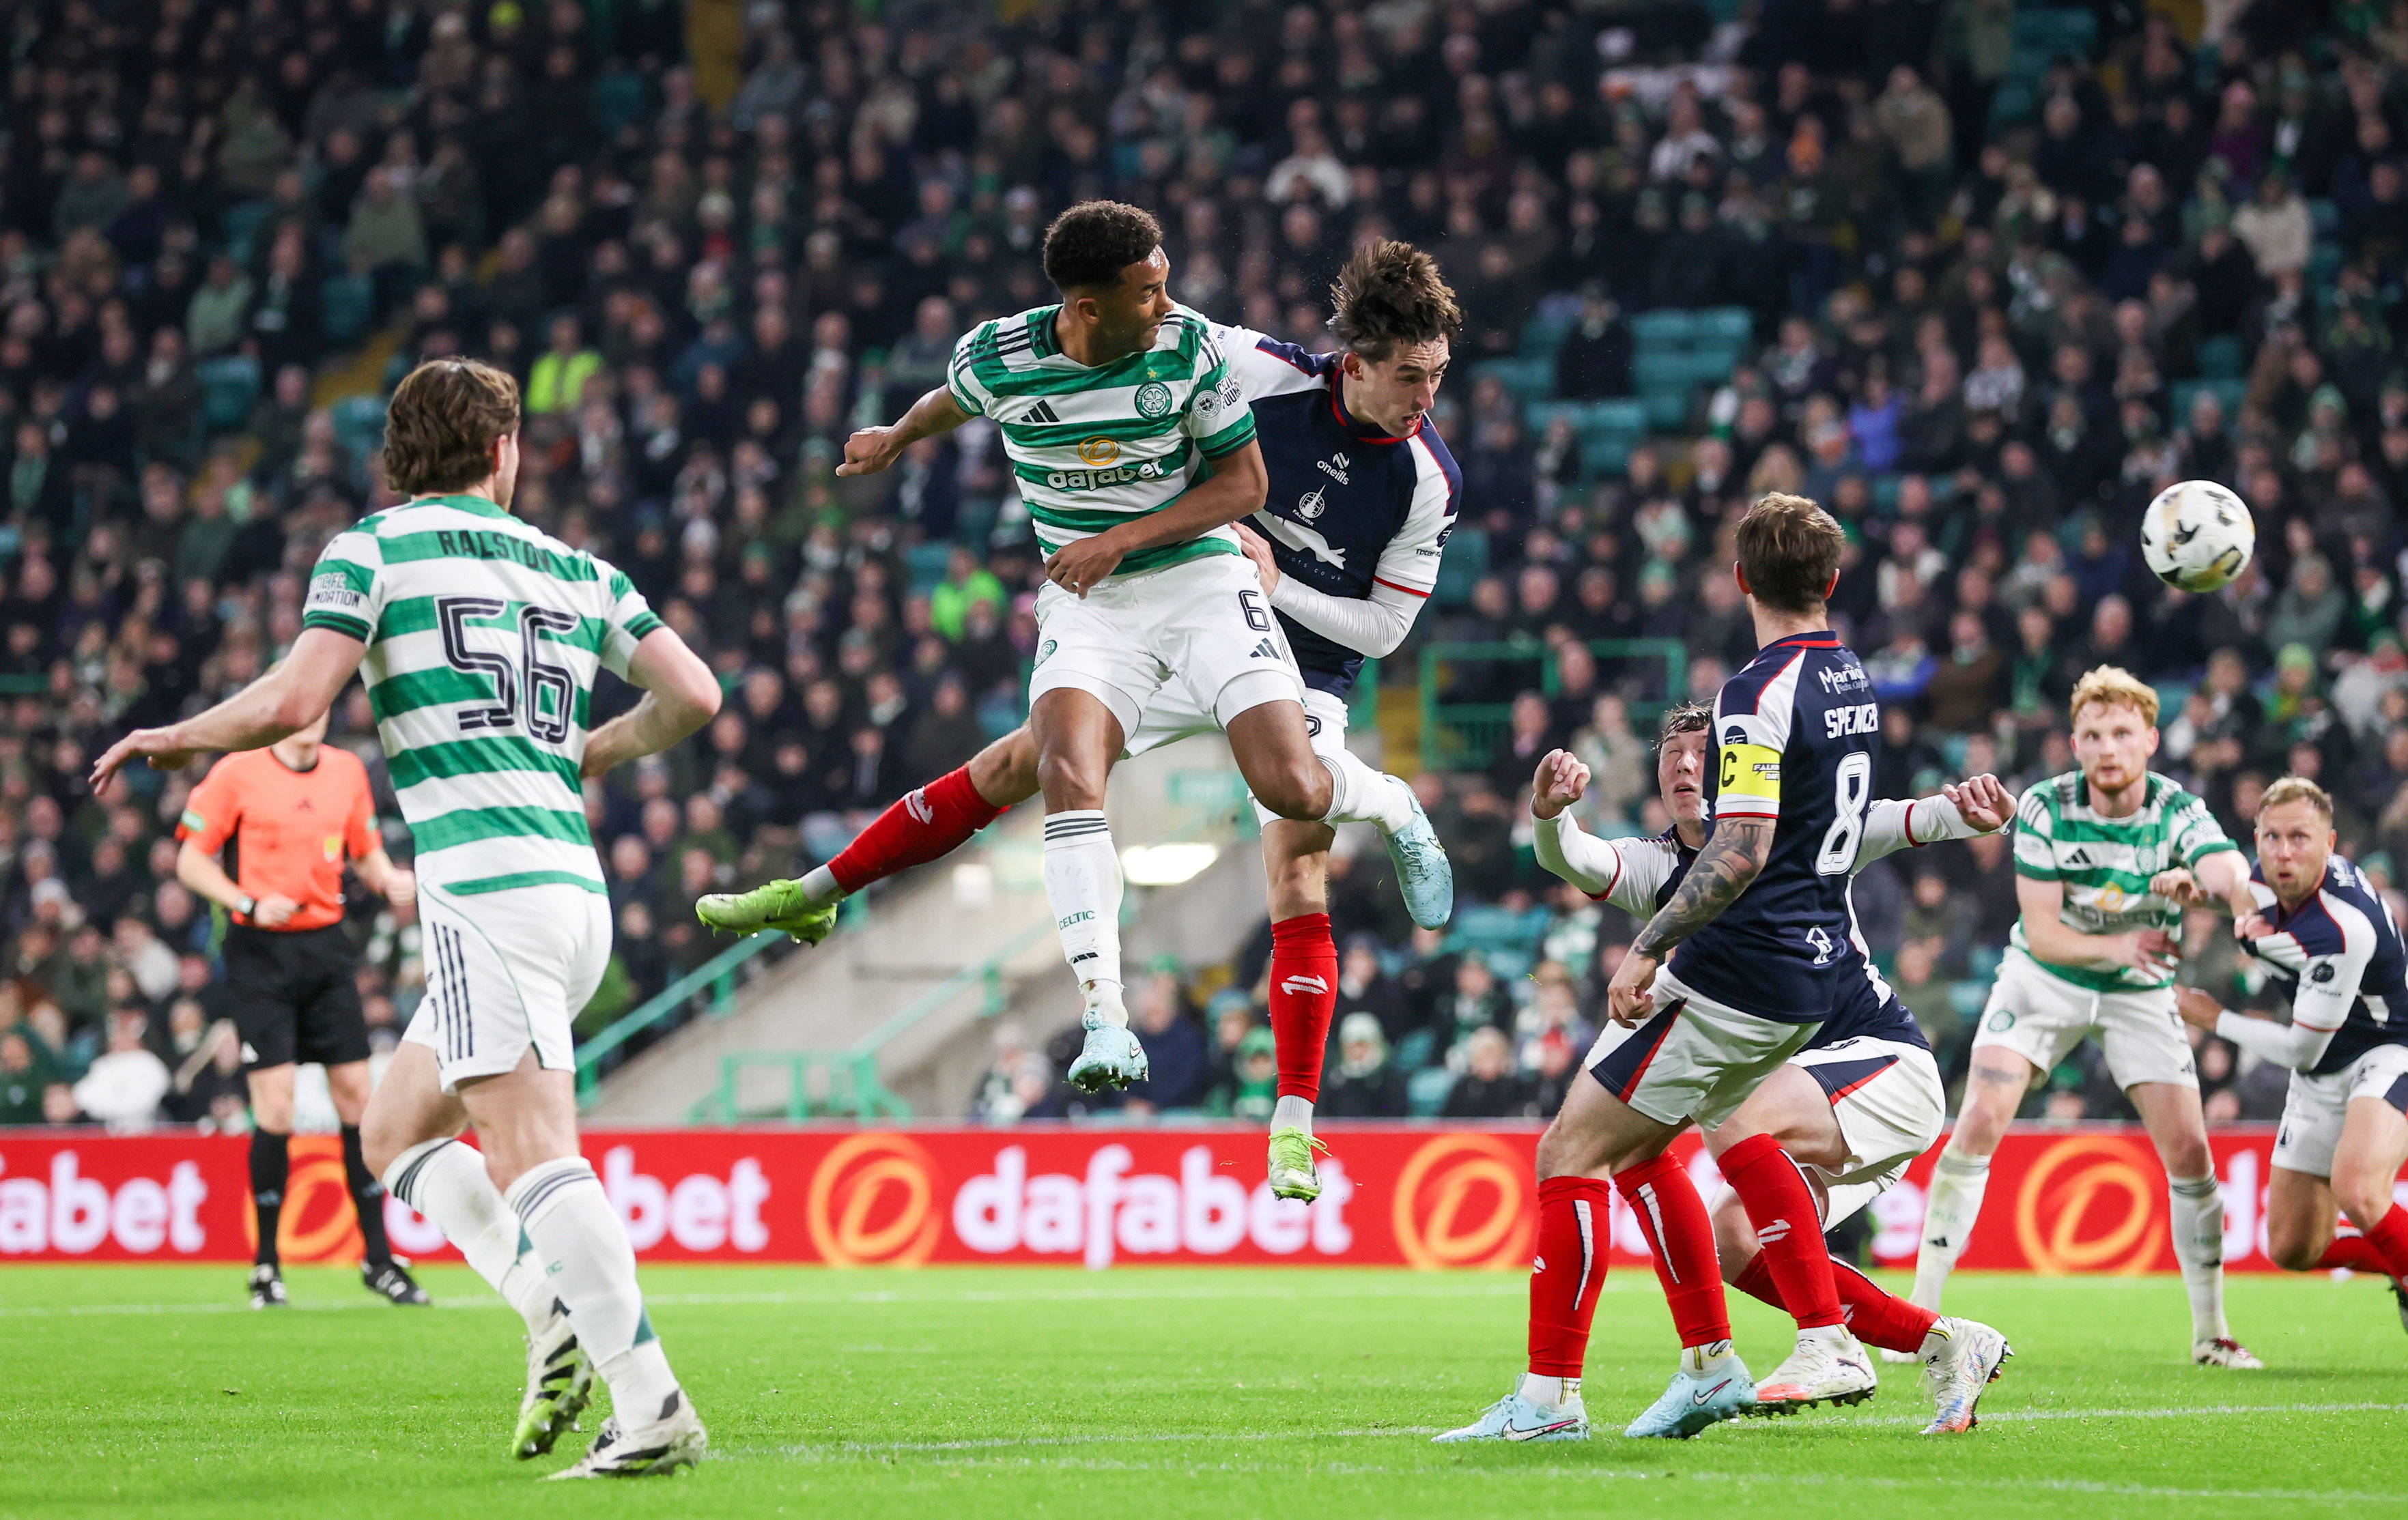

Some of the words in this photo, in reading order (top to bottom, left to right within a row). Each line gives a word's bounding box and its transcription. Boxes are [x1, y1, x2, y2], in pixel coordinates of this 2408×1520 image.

[1316, 460, 1350, 485] o'neills
[1292, 508, 1315, 527] FALKIRK
[437, 530, 551, 573] RALSTON
[1238, 590, 1270, 632] 6
[434, 596, 582, 745] 56
[1722, 751, 1738, 787] C
[1815, 751, 1871, 876] 8
[1059, 910, 1095, 930] CELTIC
[0, 1149, 209, 1253] abet
[954, 1144, 1352, 1271] dafabet
